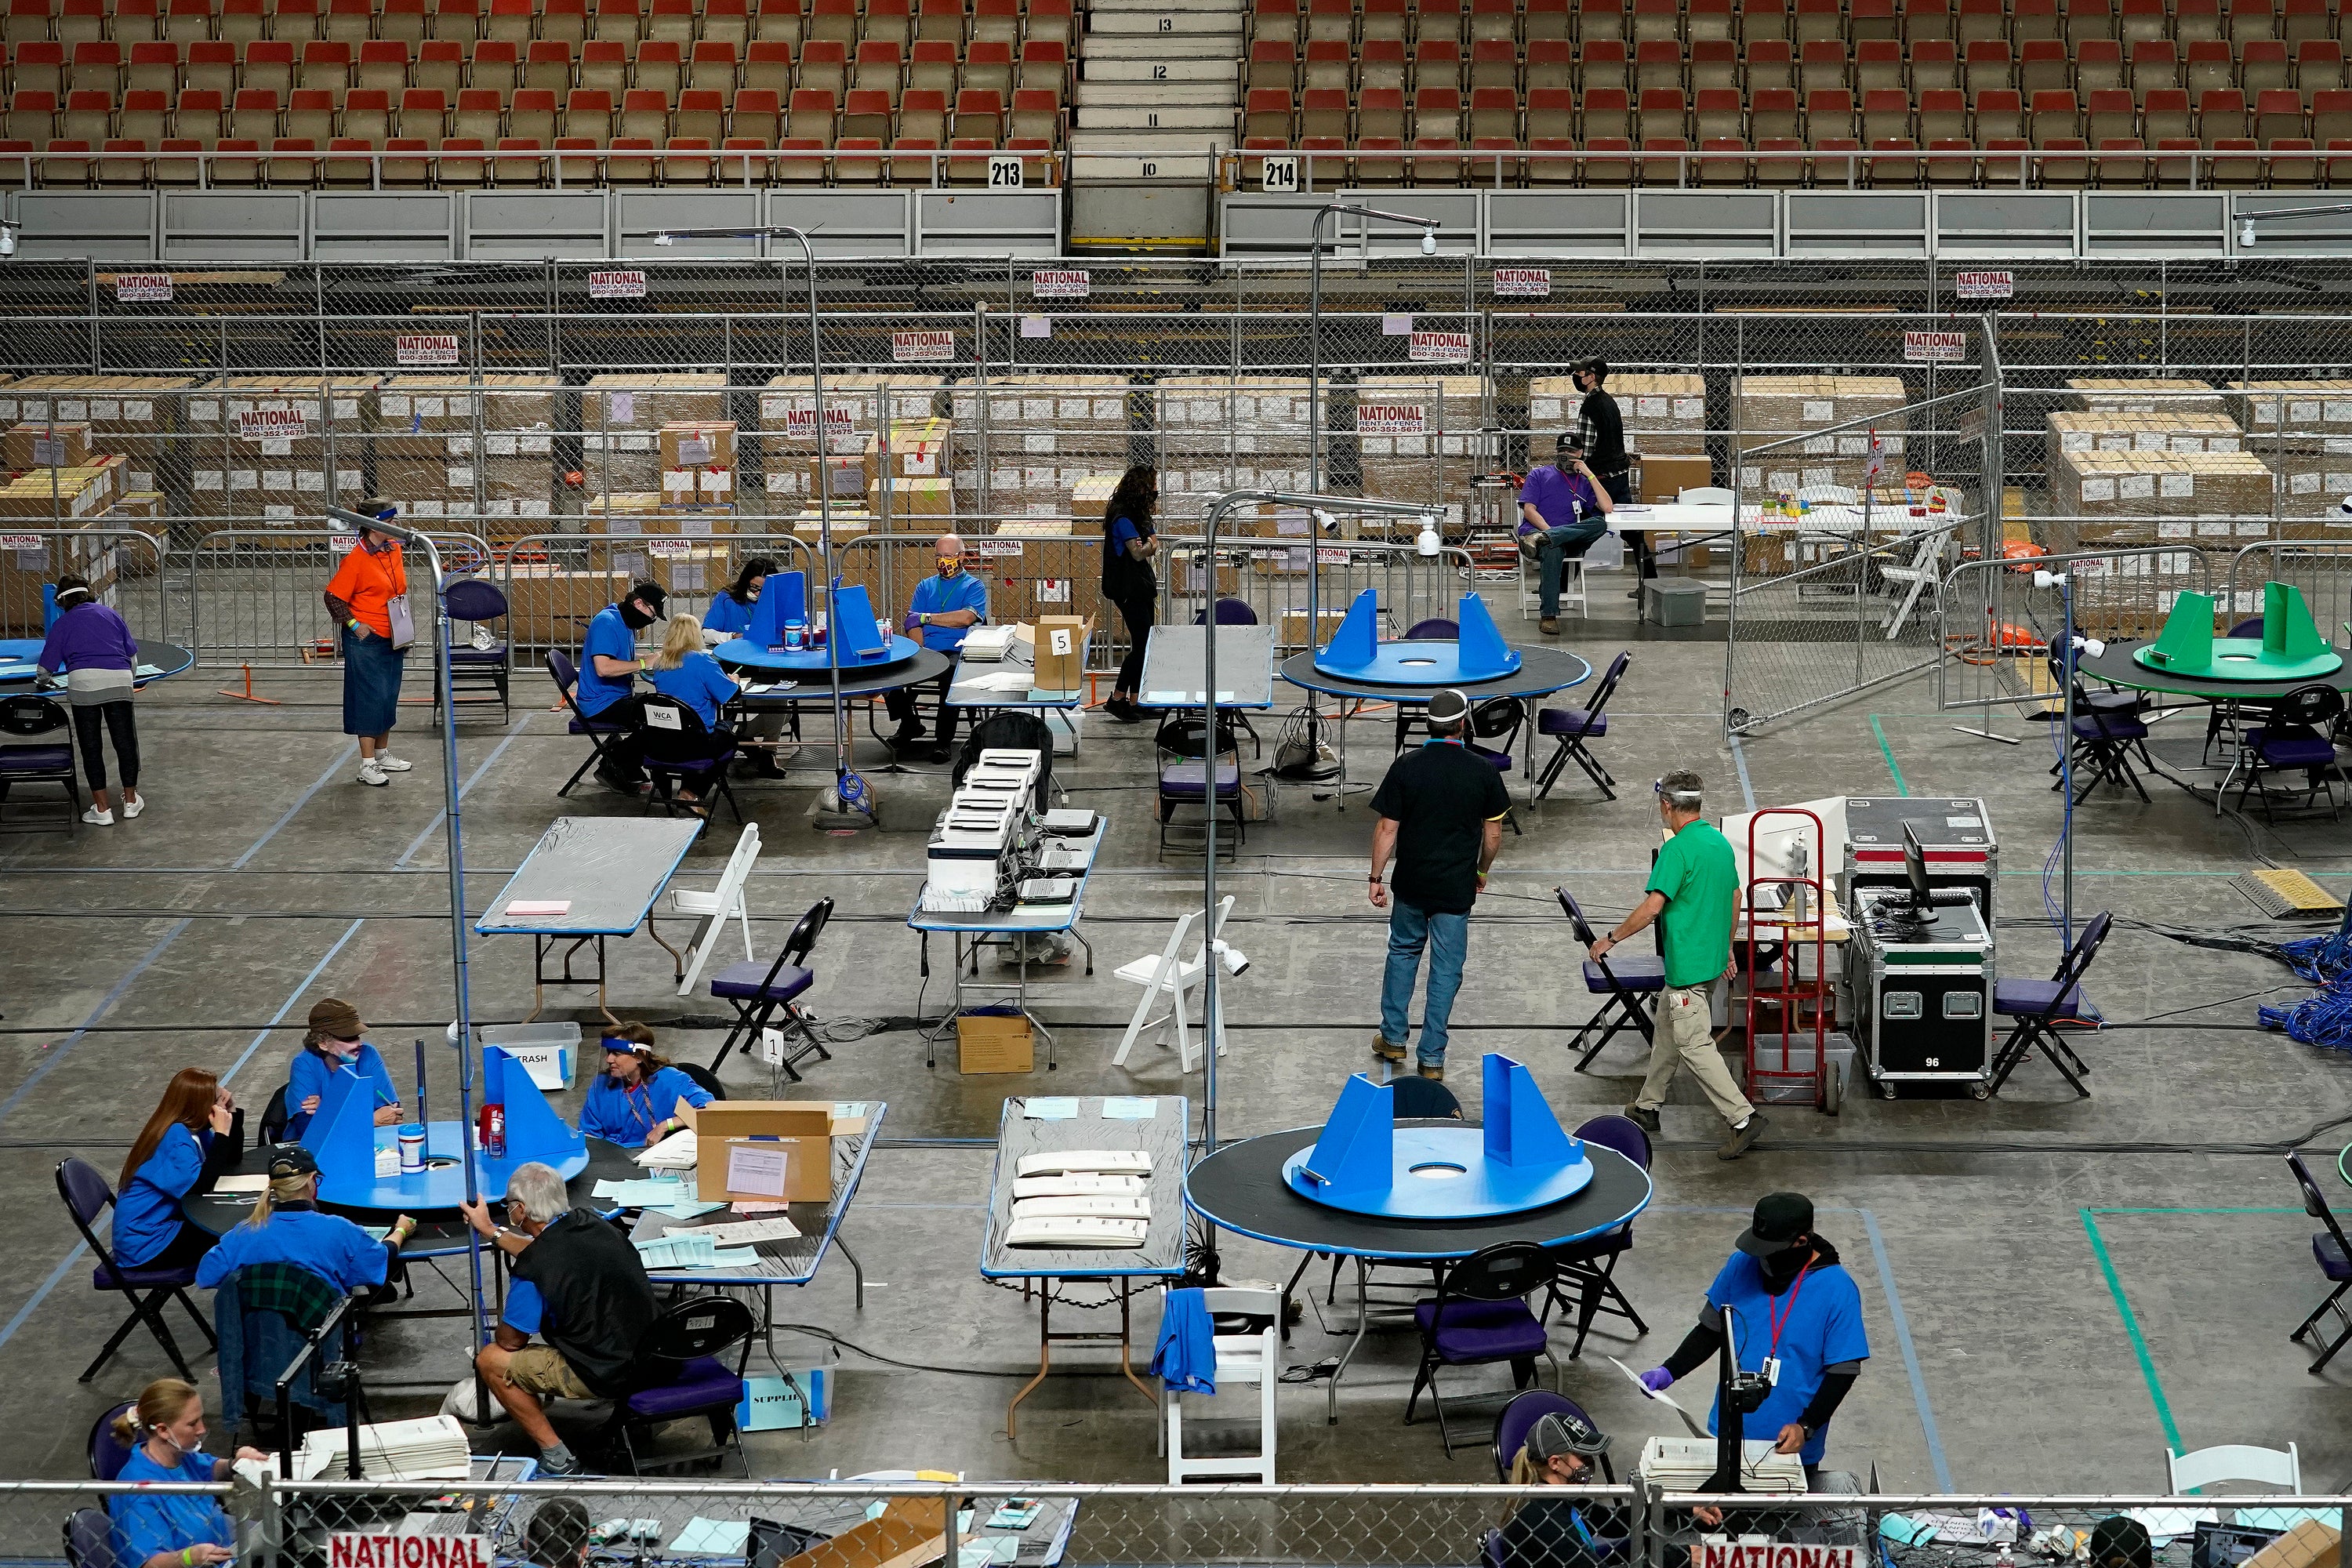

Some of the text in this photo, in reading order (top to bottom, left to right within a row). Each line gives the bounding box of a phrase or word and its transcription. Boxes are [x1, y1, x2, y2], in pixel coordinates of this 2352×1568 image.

[1160, 19, 1171, 31] 13
[1154, 65, 1167, 78] 12
[1149, 113, 1157, 126] 11
[992, 162, 1020, 186] 213
[1143, 162, 1156, 176] 10
[1266, 162, 1294, 186] 214
[118, 276, 171, 288] NATIONAL
[591, 272, 644, 285] NATIONAL
[1035, 272, 1087, 284] NATIONAL
[1496, 270, 1549, 282] NATIONAL
[1958, 273, 2011, 285] NATIONAL
[399, 337, 456, 350] NATIONAL
[895, 333, 952, 347] NATIONAL
[1411, 333, 1469, 347] NATIONAL
[1907, 333, 1964, 347] NATIONAL
[241, 410, 305, 426] NATIONAL
[1359, 406, 1422, 420] NATIONAL
[1867, 448, 1883, 463] GATE
[1316, 549, 1348, 557] ATIONAL
[2071, 559, 2103, 568] NATIONAL
[1058, 636, 1066, 649] 5
[653, 710, 673, 720] WCA
[770, 1038, 778, 1056] 1
[517, 1054, 547, 1063] TRASH
[1926, 1058, 1940, 1067] 96
[753, 1393, 800, 1404] SUPPLIE
[332, 1535, 488, 1568] NATIONAL
